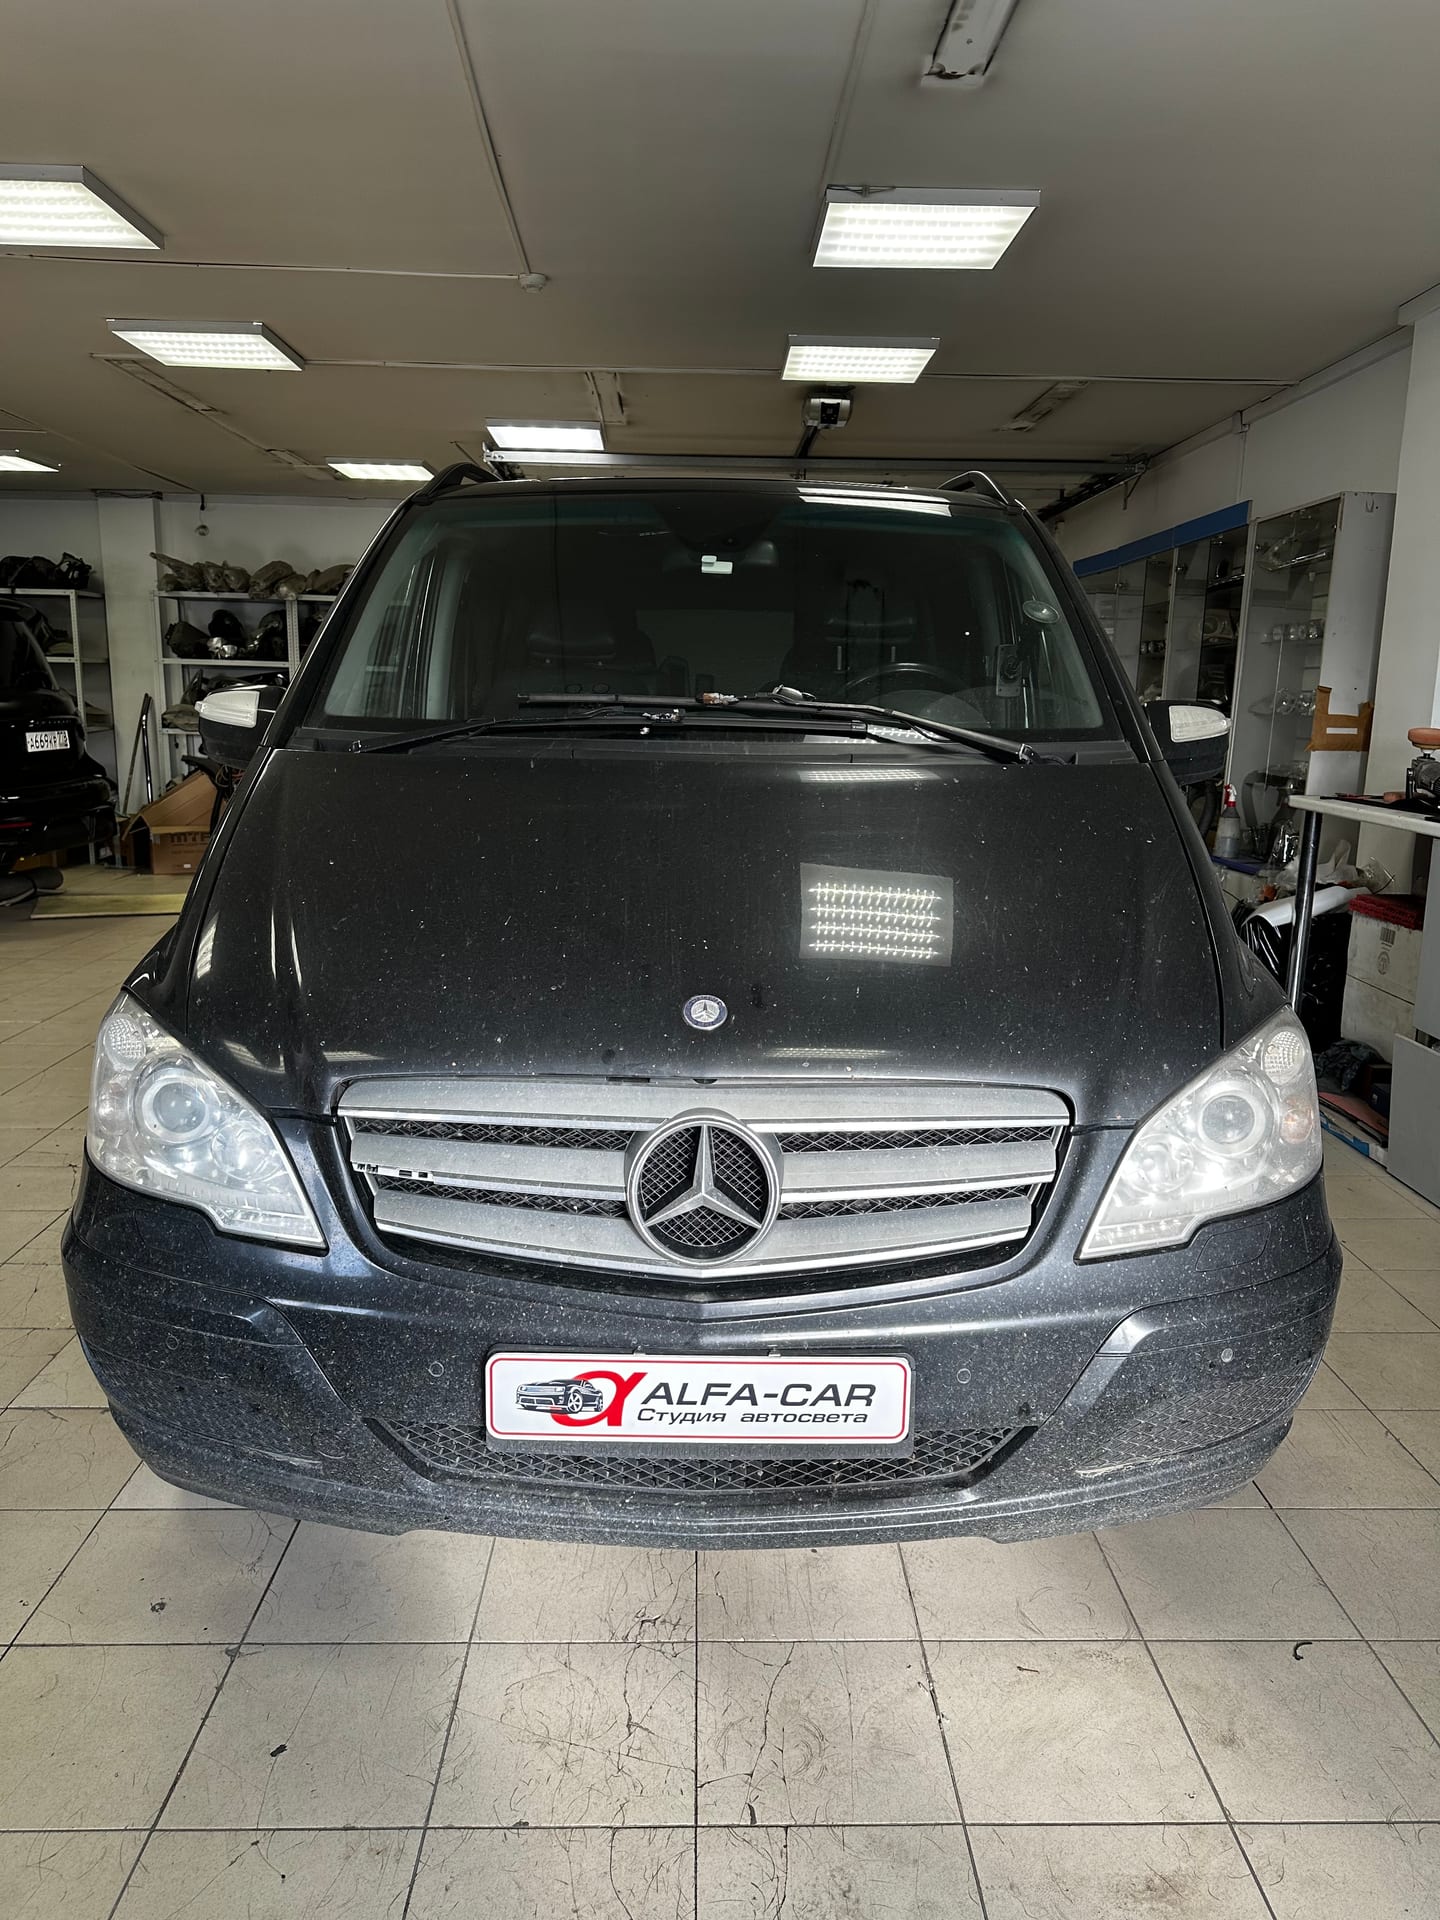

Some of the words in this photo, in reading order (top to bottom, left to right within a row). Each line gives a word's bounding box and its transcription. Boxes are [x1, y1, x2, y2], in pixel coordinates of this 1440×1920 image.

[641, 1382, 877, 1407] ALFA-CAR
[637, 1408, 726, 1425] Студия
[740, 1412, 868, 1423] автосвета
